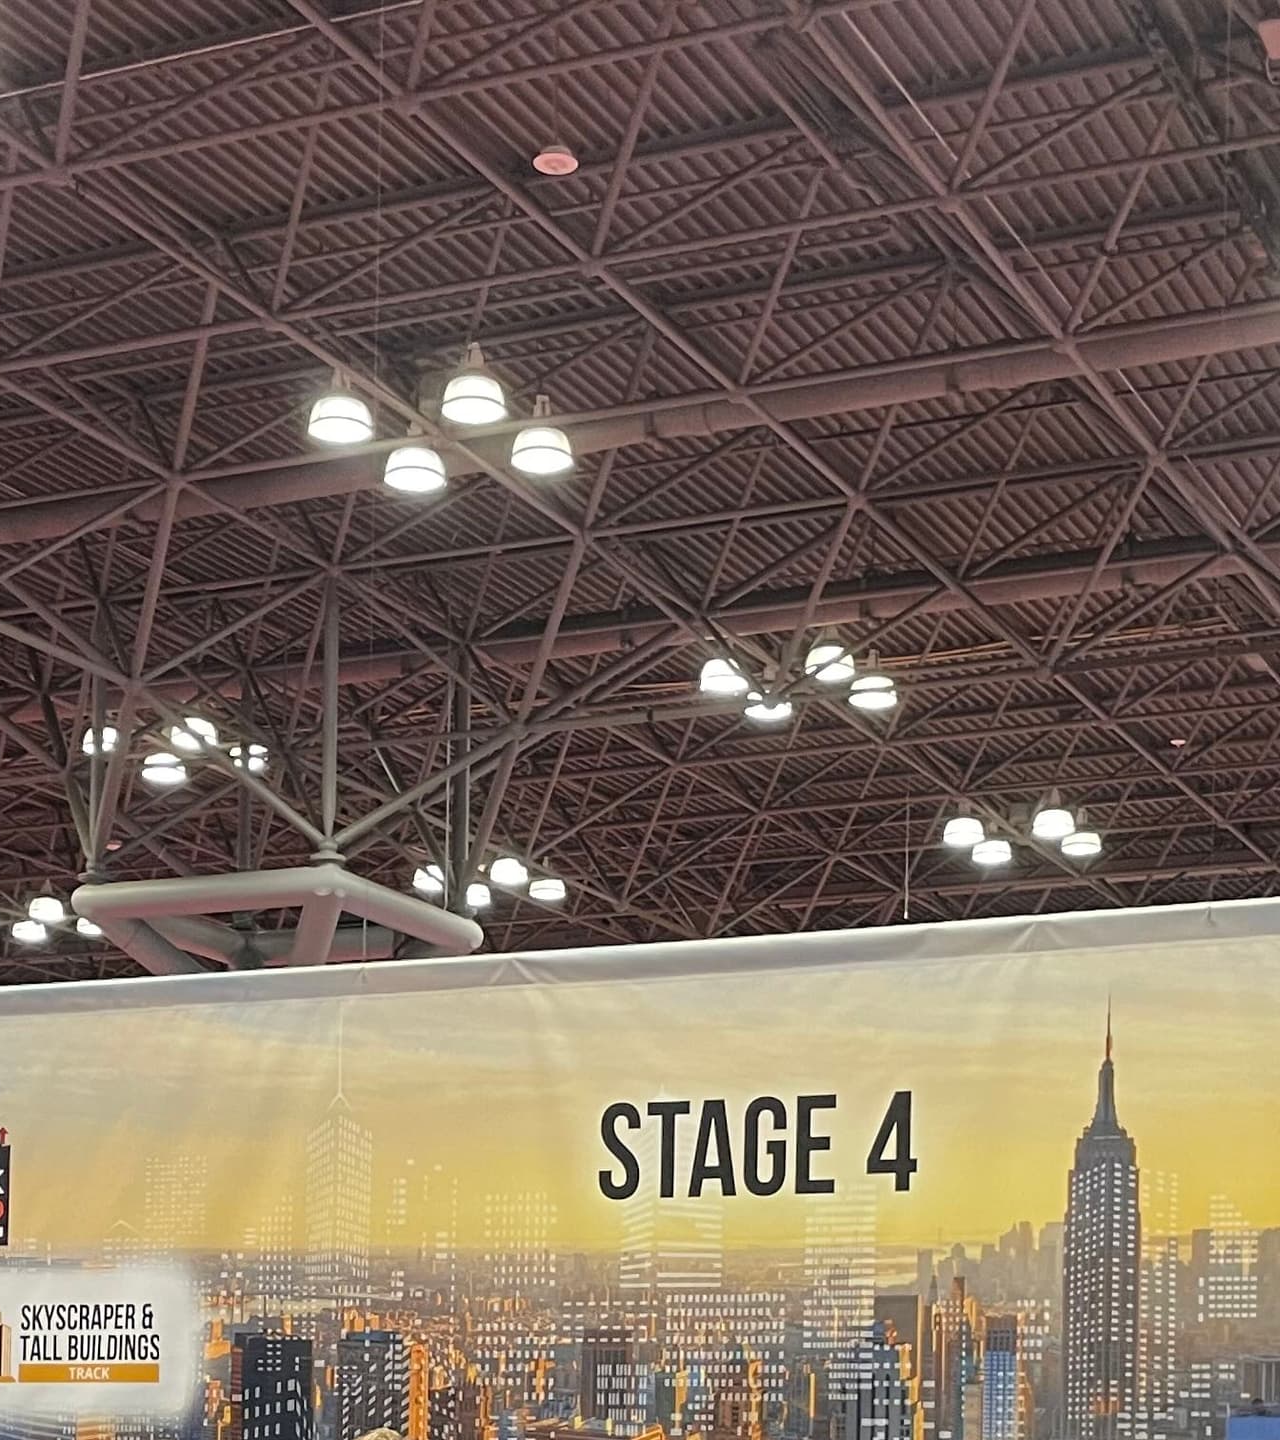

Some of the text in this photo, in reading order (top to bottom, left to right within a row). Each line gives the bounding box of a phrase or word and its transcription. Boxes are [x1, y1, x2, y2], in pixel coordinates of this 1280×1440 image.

[599, 1090, 918, 1200] STAGE 4
[20, 1303, 154, 1331] SKYSCRAPER &
[19, 1334, 161, 1362] TALL BUILDINGS
[68, 1367, 111, 1380] TRACK
